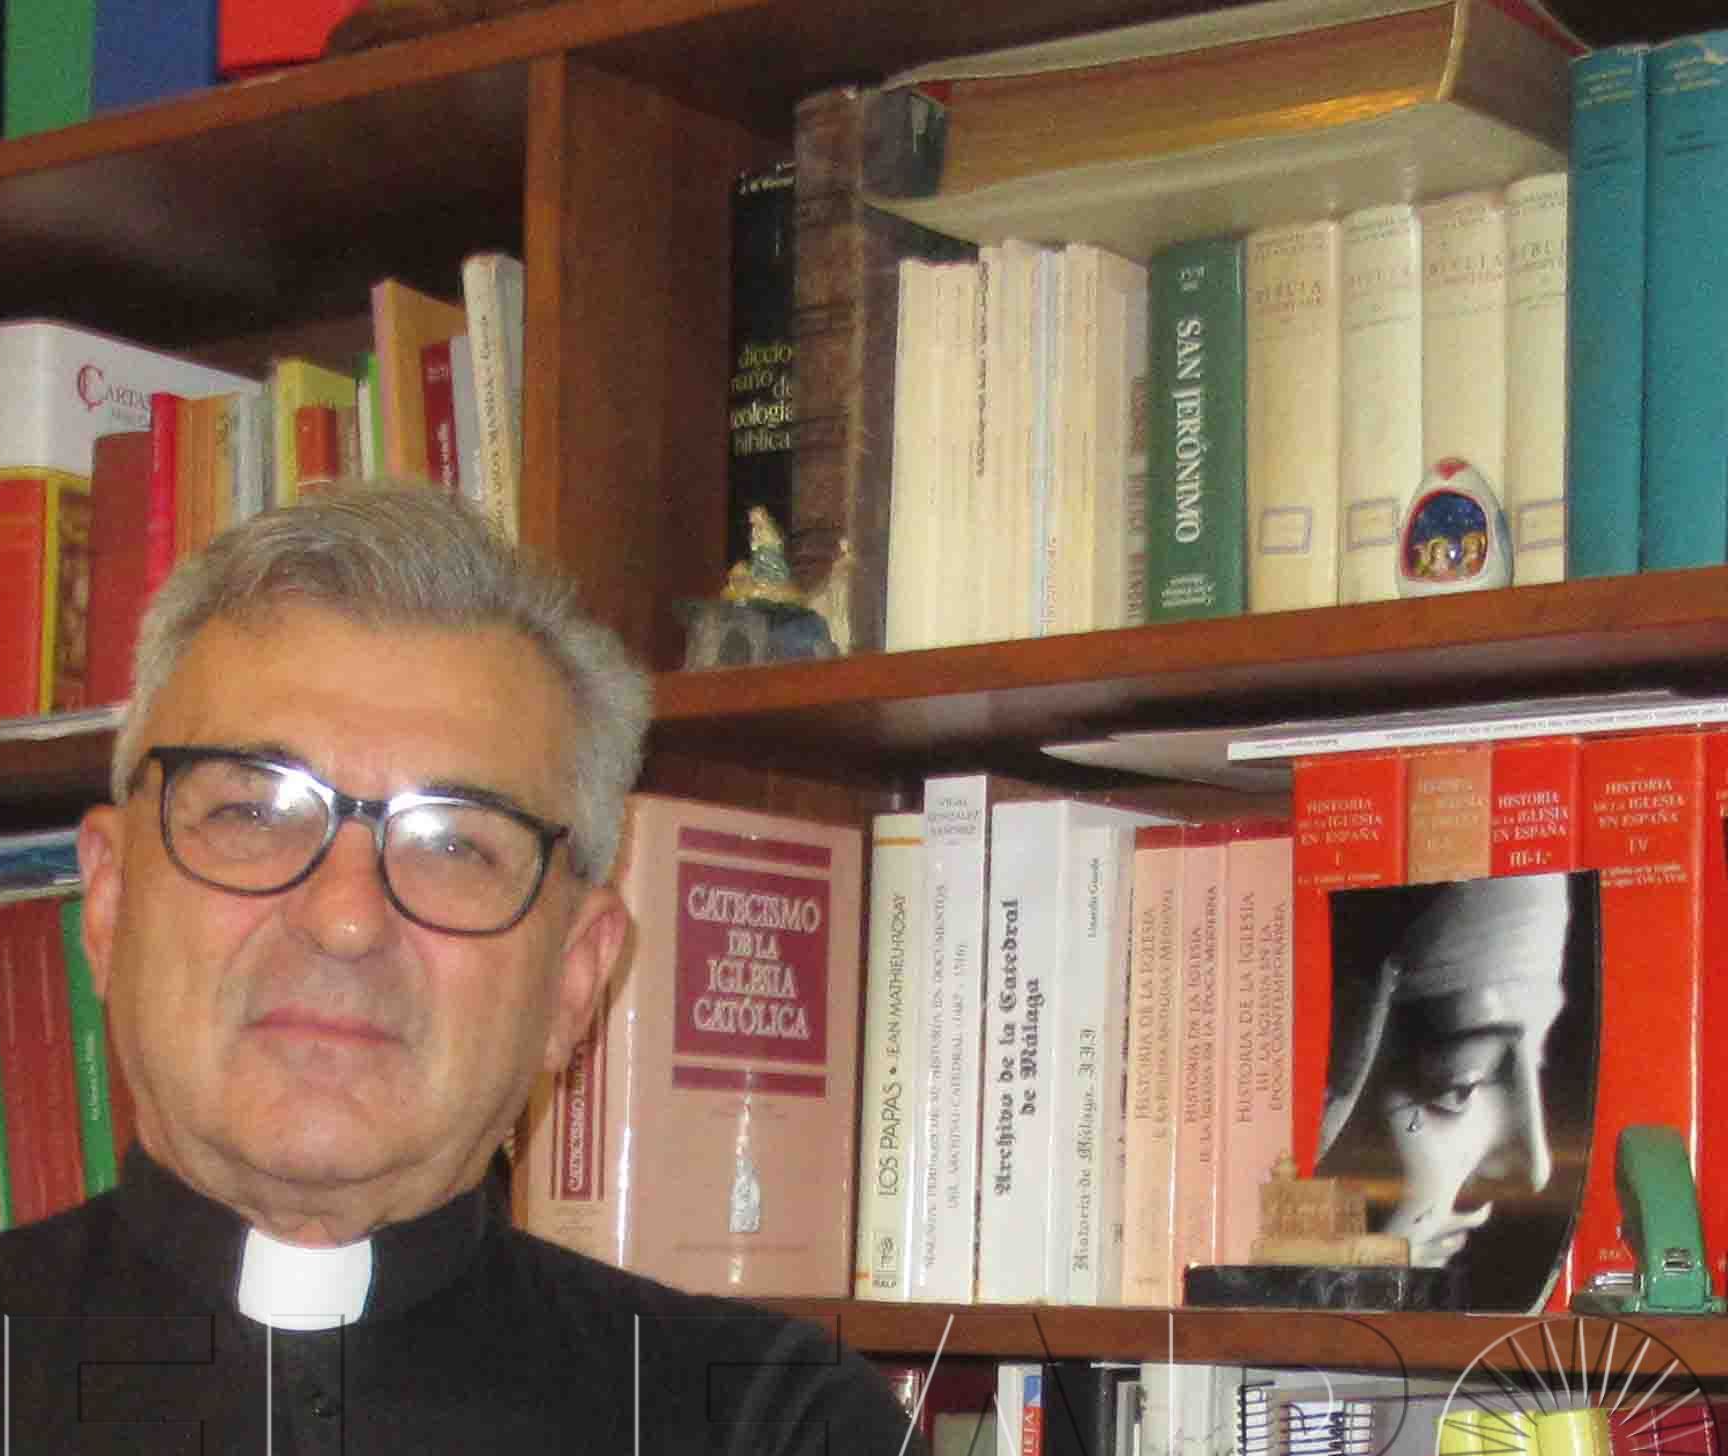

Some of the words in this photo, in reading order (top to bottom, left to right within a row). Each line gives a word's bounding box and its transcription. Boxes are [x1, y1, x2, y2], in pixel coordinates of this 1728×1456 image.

[1175, 318, 1204, 379] SAN
[1172, 387, 1205, 544] JERÓNIMO
[1306, 795, 1373, 818] HISTORIA
[1497, 789, 1560, 811] HISTORIA
[1604, 776, 1673, 798] HISTORIA
[1628, 793, 1686, 813] IGLESIA
[1324, 828, 1381, 843] ESPAÑA
[1328, 813, 1384, 831] IGLESIA
[1514, 821, 1569, 840] ESPAÑA
[1518, 804, 1570, 824] IGLESIA
[1621, 808, 1681, 828] ESPAÑA
[686, 882, 821, 935] CATECISMO
[1238, 892, 1257, 964] IGLESIA
[727, 928, 753, 959] DE
[755, 933, 779, 962] LA
[995, 898, 1020, 1013] Catedral
[1138, 907, 1156, 973] IGLESIA
[706, 957, 796, 1001] IGLESIA
[1238, 971, 1256, 993] LA
[692, 994, 810, 1041] CATÓLICA
[1019, 976, 1044, 1080] Málaga
[1238, 1000, 1255, 1024] DE
[887, 1020, 906, 1064] JEAN
[997, 1023, 1017, 1046] la
[996, 1053, 1015, 1084] de
[1136, 1029, 1154, 1121] HISTORIA
[1184, 1045, 1202, 1124] HISTORIA
[1237, 1030, 1255, 1124] HISTORIA
[878, 1081, 904, 1151] PAPAS
[1019, 1088, 1038, 1117] de
[993, 1093, 1022, 1197] Archivo
[876, 1152, 902, 1198] LOS
[1072, 1194, 1091, 1272] Historia
